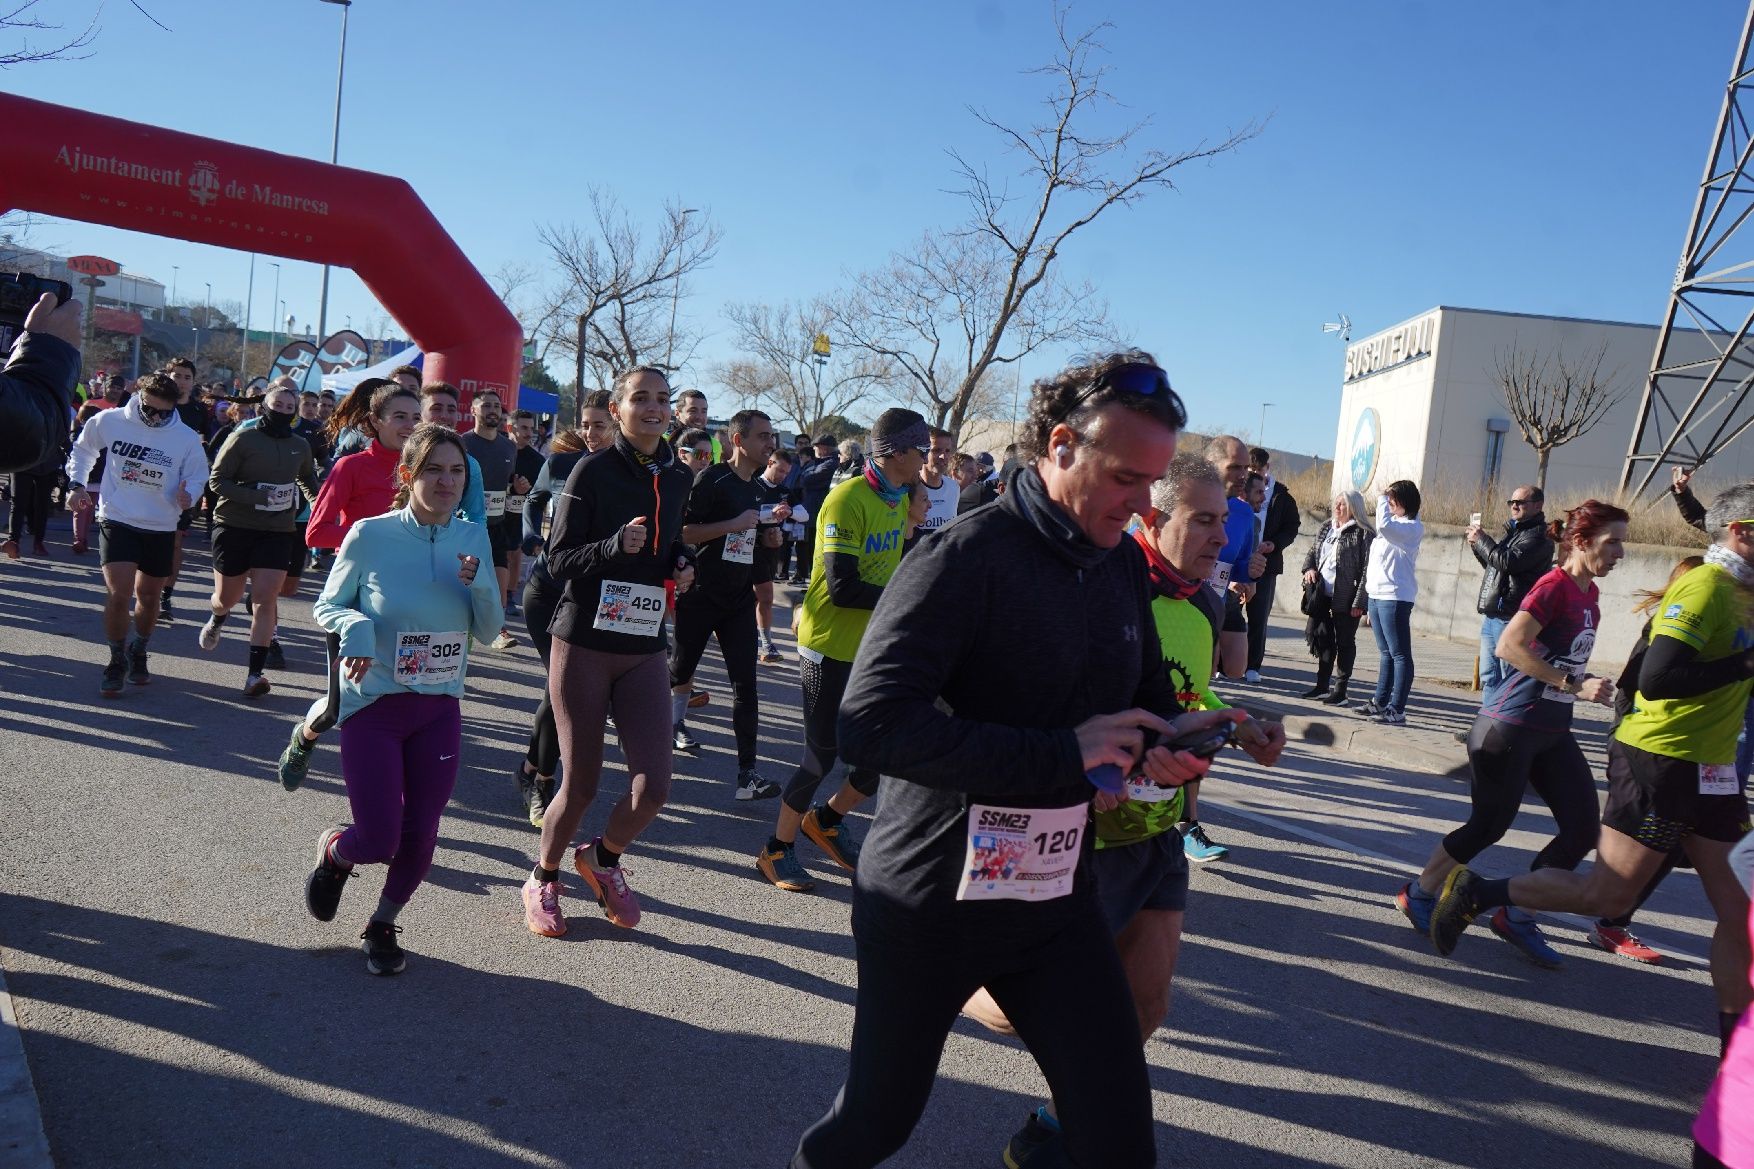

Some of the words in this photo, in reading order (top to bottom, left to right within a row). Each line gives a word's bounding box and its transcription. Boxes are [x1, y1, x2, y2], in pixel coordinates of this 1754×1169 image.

[55, 143, 183, 187] Ajuntament
[224, 180, 246, 200] de
[252, 183, 329, 216] Manresa
[111, 440, 152, 461] CUBE
[142, 468, 164, 479] 487
[631, 596, 662, 612] 420
[401, 634, 431, 645] SSM23
[431, 642, 462, 658] 302
[978, 810, 1031, 830] SSM23
[1034, 828, 1078, 856] 120
